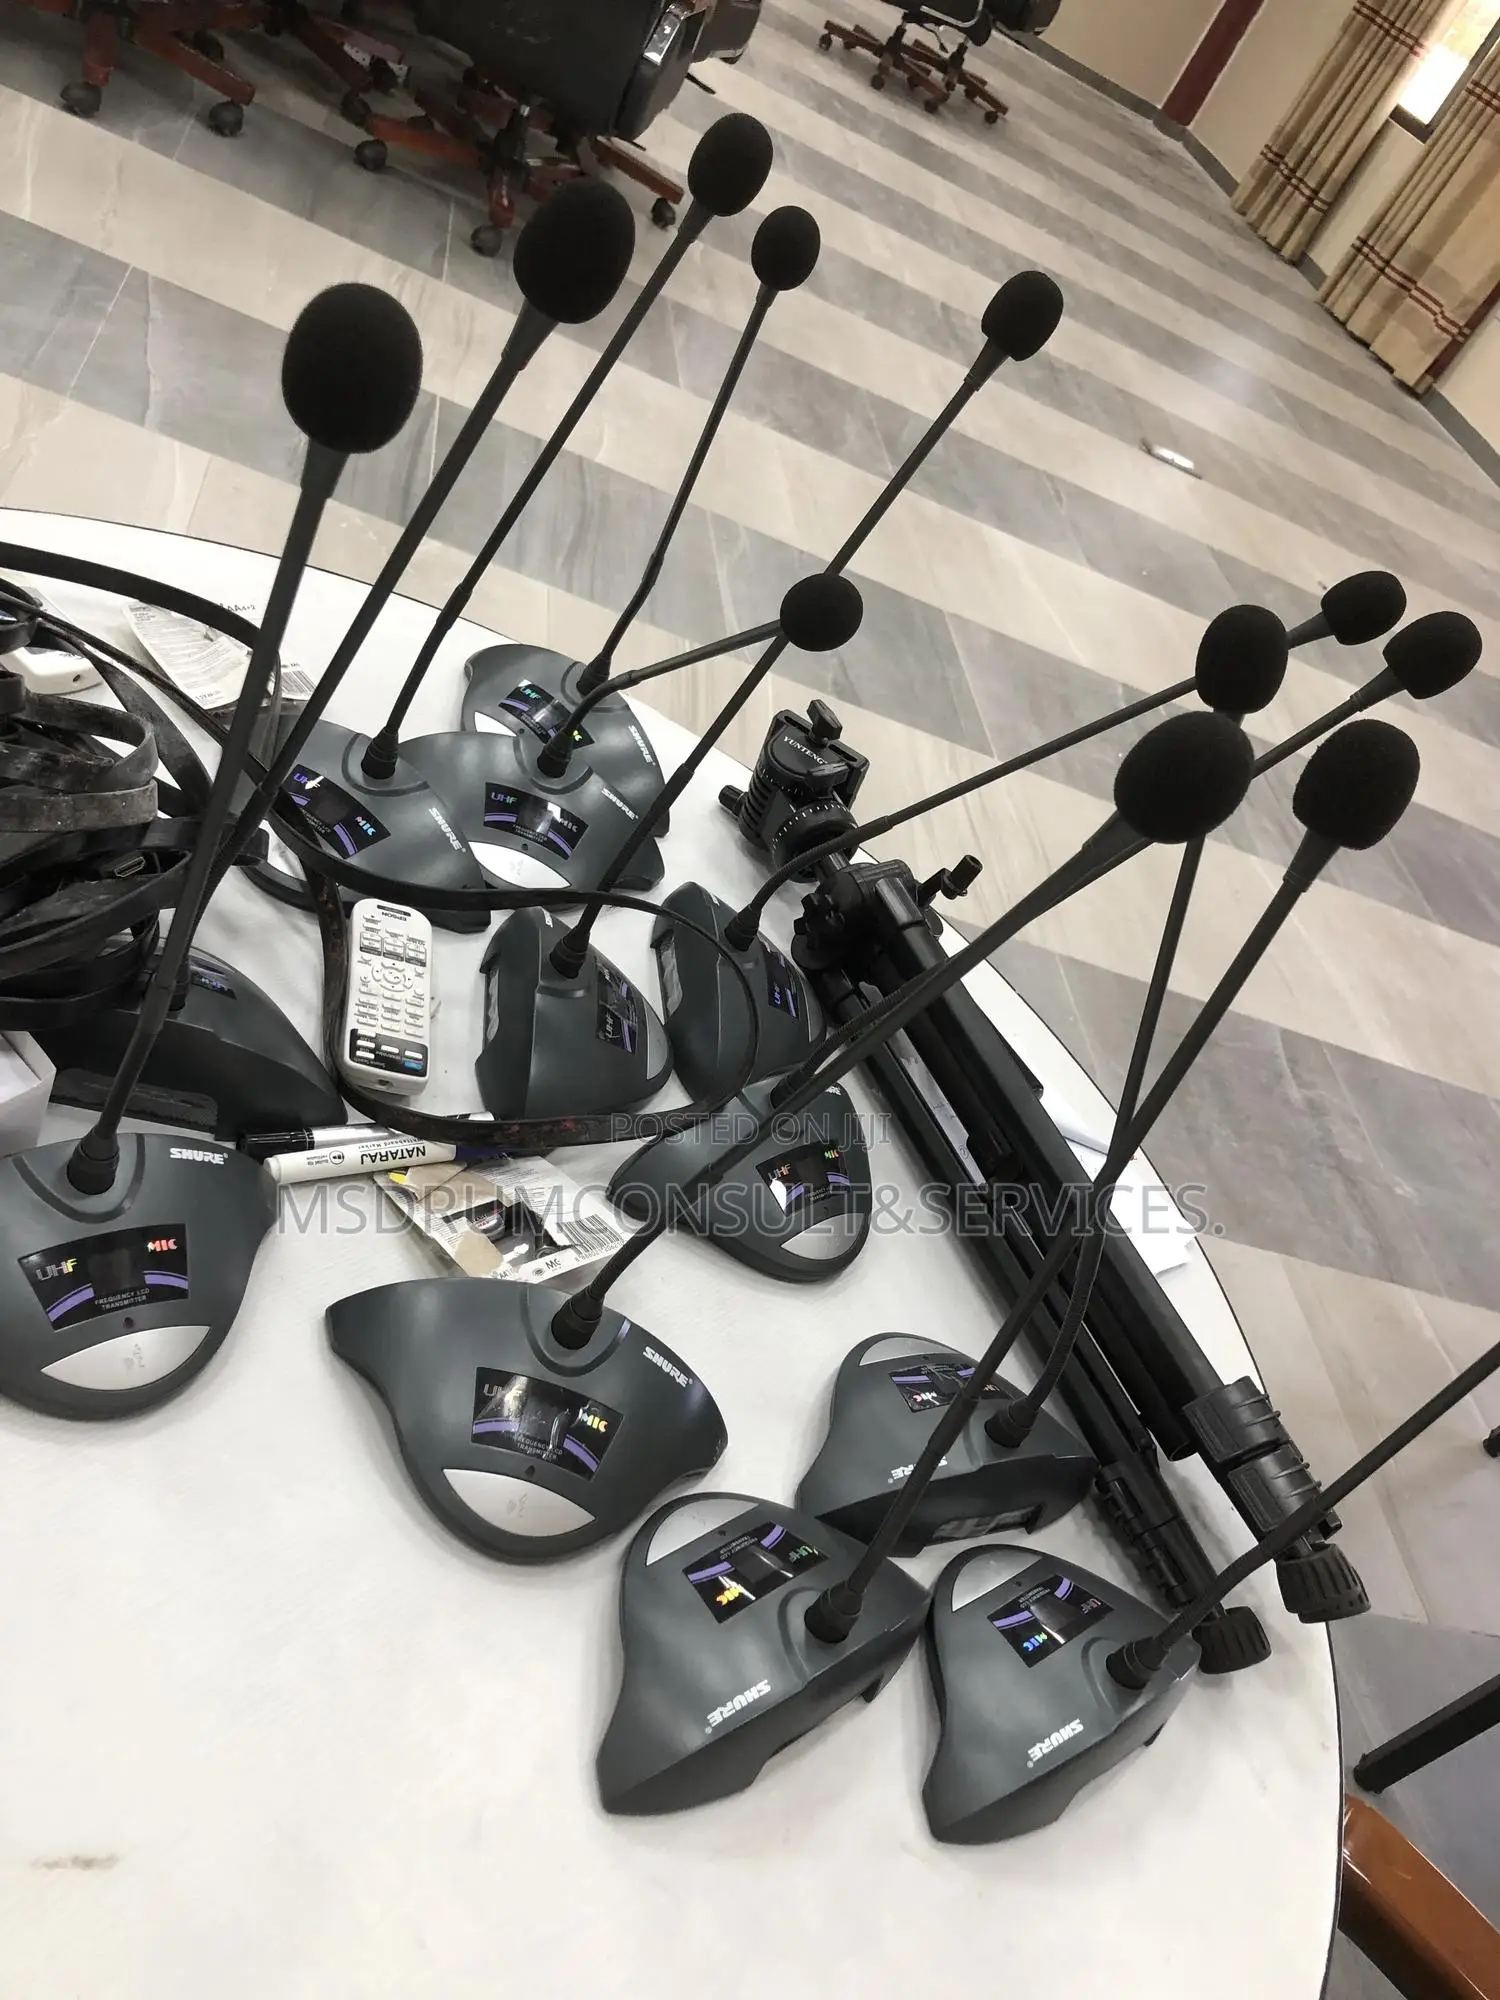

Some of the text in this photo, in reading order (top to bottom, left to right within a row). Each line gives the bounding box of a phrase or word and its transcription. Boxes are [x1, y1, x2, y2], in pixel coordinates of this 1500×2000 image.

[628, 725, 653, 764] SHURE
[783, 736, 825, 764] YUNTENG
[491, 791, 518, 804] UHF
[601, 788, 636, 821] SHURE
[355, 816, 377, 837] MIC
[428, 807, 464, 852] SHURE
[559, 817, 579, 833] MIC
[169, 1147, 225, 1165] SHURE
[360, 1145, 426, 1166] NATARAJ
[824, 1149, 840, 1159] MIC
[768, 1163, 791, 1180] UHF
[148, 1238, 178, 1253] MIC
[36, 1257, 78, 1281] UHF
[95, 1292, 135, 1305] FREQUENCY
[643, 1346, 689, 1388] SHURE
[581, 1412, 609, 1433] MIC
[788, 1545, 813, 1564] UHF
[1023, 1631, 1048, 1652] MIC
[706, 1679, 772, 1728] SHURE
[1027, 1718, 1084, 1762] SHURE
